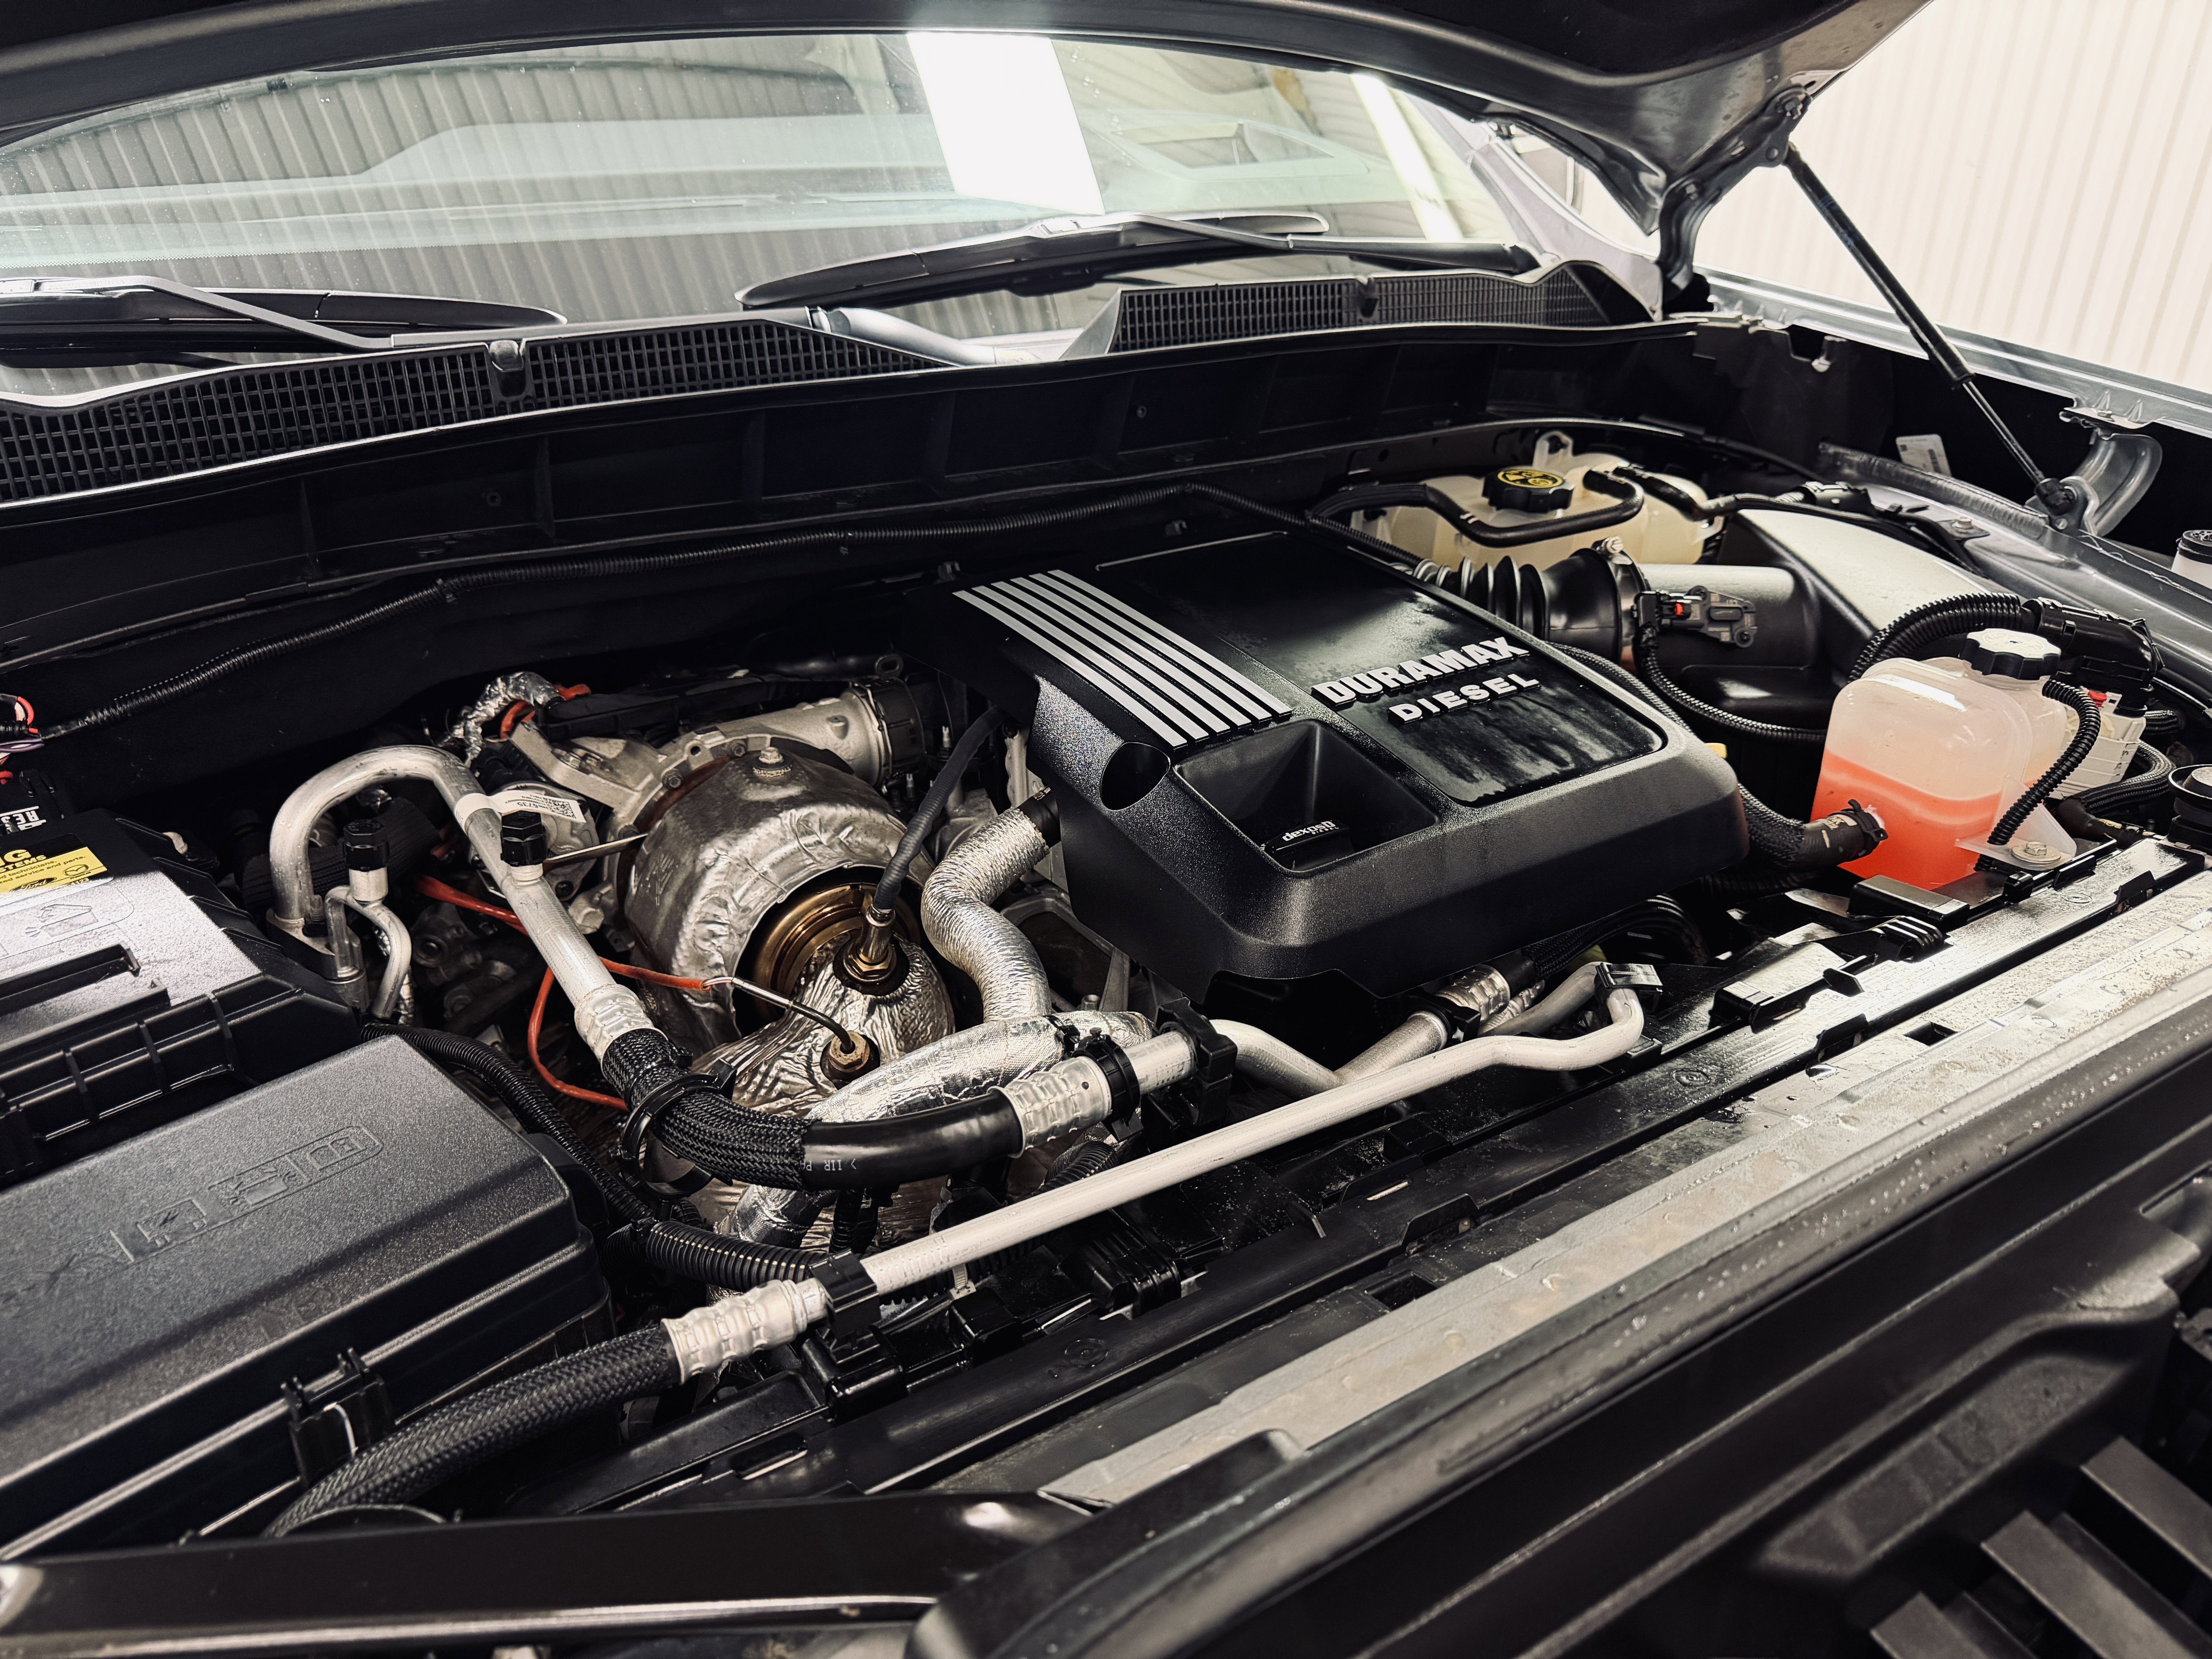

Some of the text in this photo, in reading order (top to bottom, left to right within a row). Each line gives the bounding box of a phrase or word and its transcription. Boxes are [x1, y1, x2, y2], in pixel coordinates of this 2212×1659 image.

[1312, 637, 1530, 704] DURAMAX
[1388, 674, 1540, 722] DIESEL
[1282, 821, 1336, 842] dexosD
